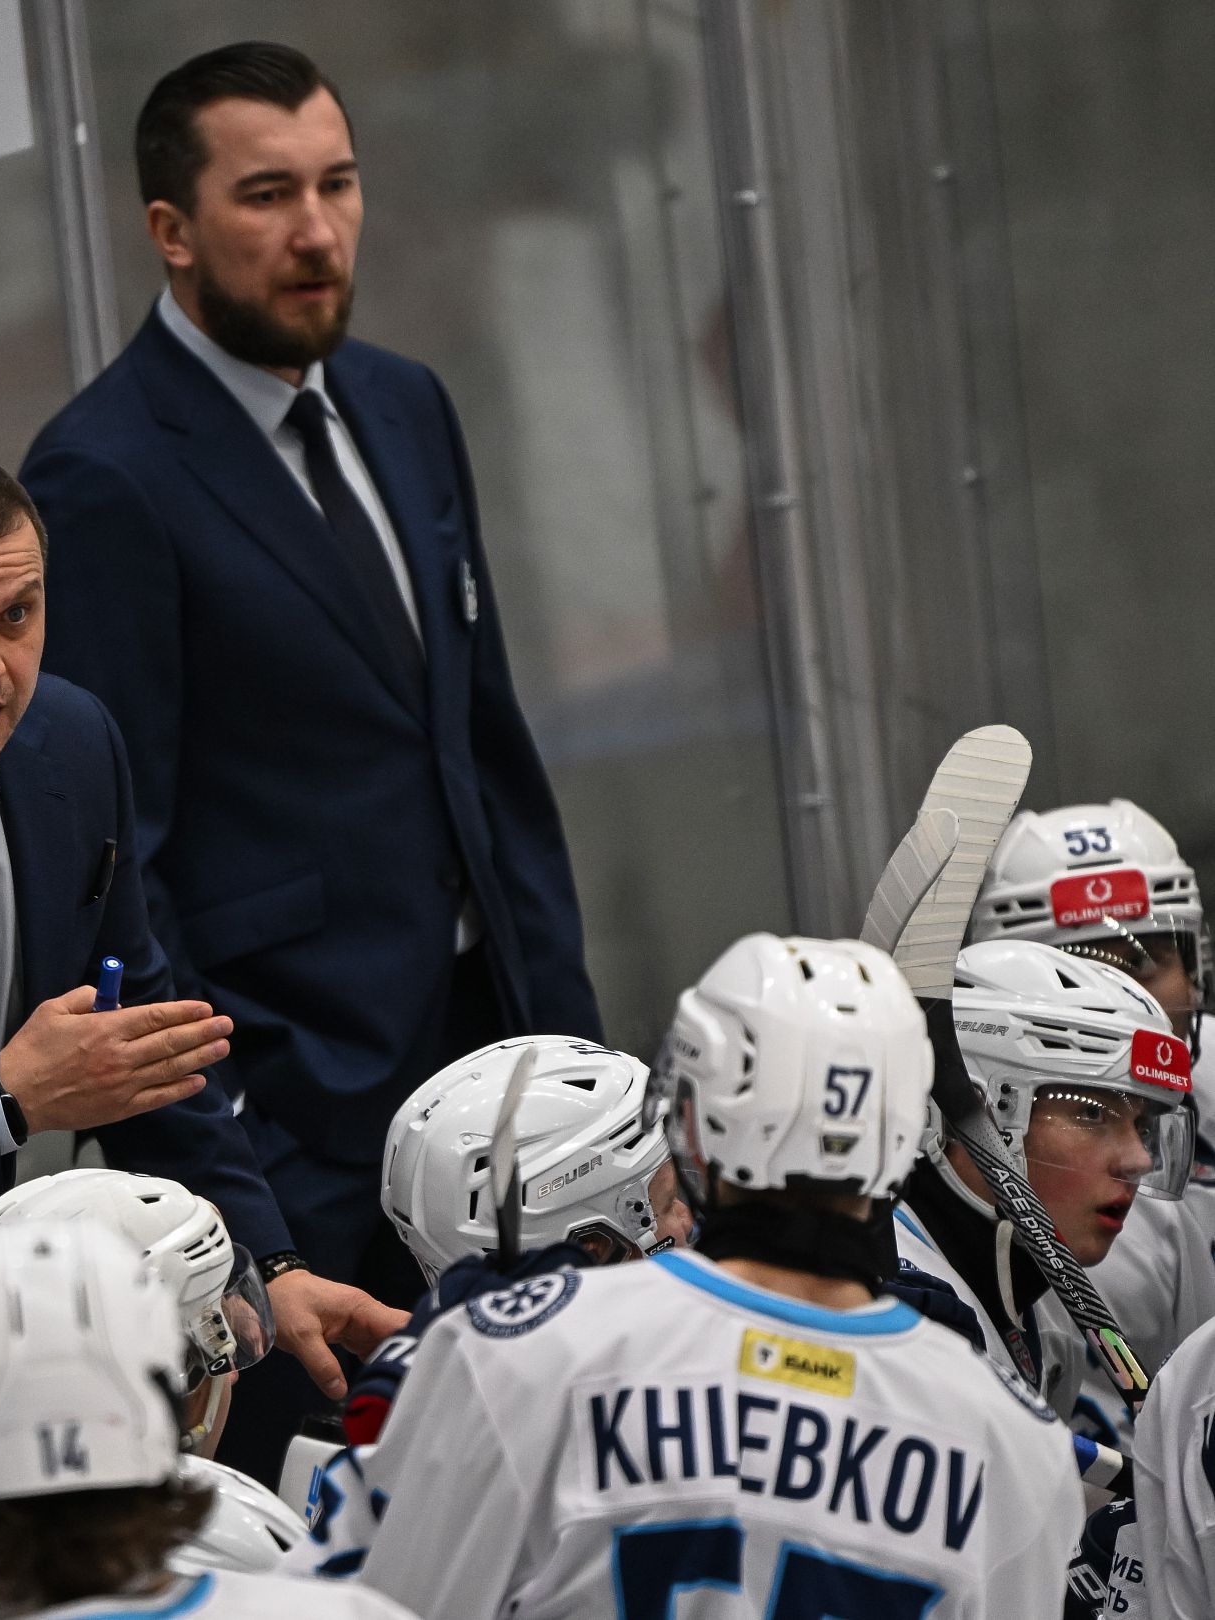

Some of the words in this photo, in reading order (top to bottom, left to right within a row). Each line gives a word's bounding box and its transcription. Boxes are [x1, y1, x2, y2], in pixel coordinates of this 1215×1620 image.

[1064, 827, 1112, 856] 53
[1061, 902, 1144, 923] OLIMPBET
[823, 1065, 872, 1117] 57
[1135, 1064, 1189, 1088] OLIMPBET
[537, 1154, 603, 1199] BAUER
[991, 1167, 1030, 1213] ACE
[1020, 1216, 1065, 1270] prime
[34, 1421, 89, 1478] 14
[590, 1385, 985, 1552] KHLEBKOV
